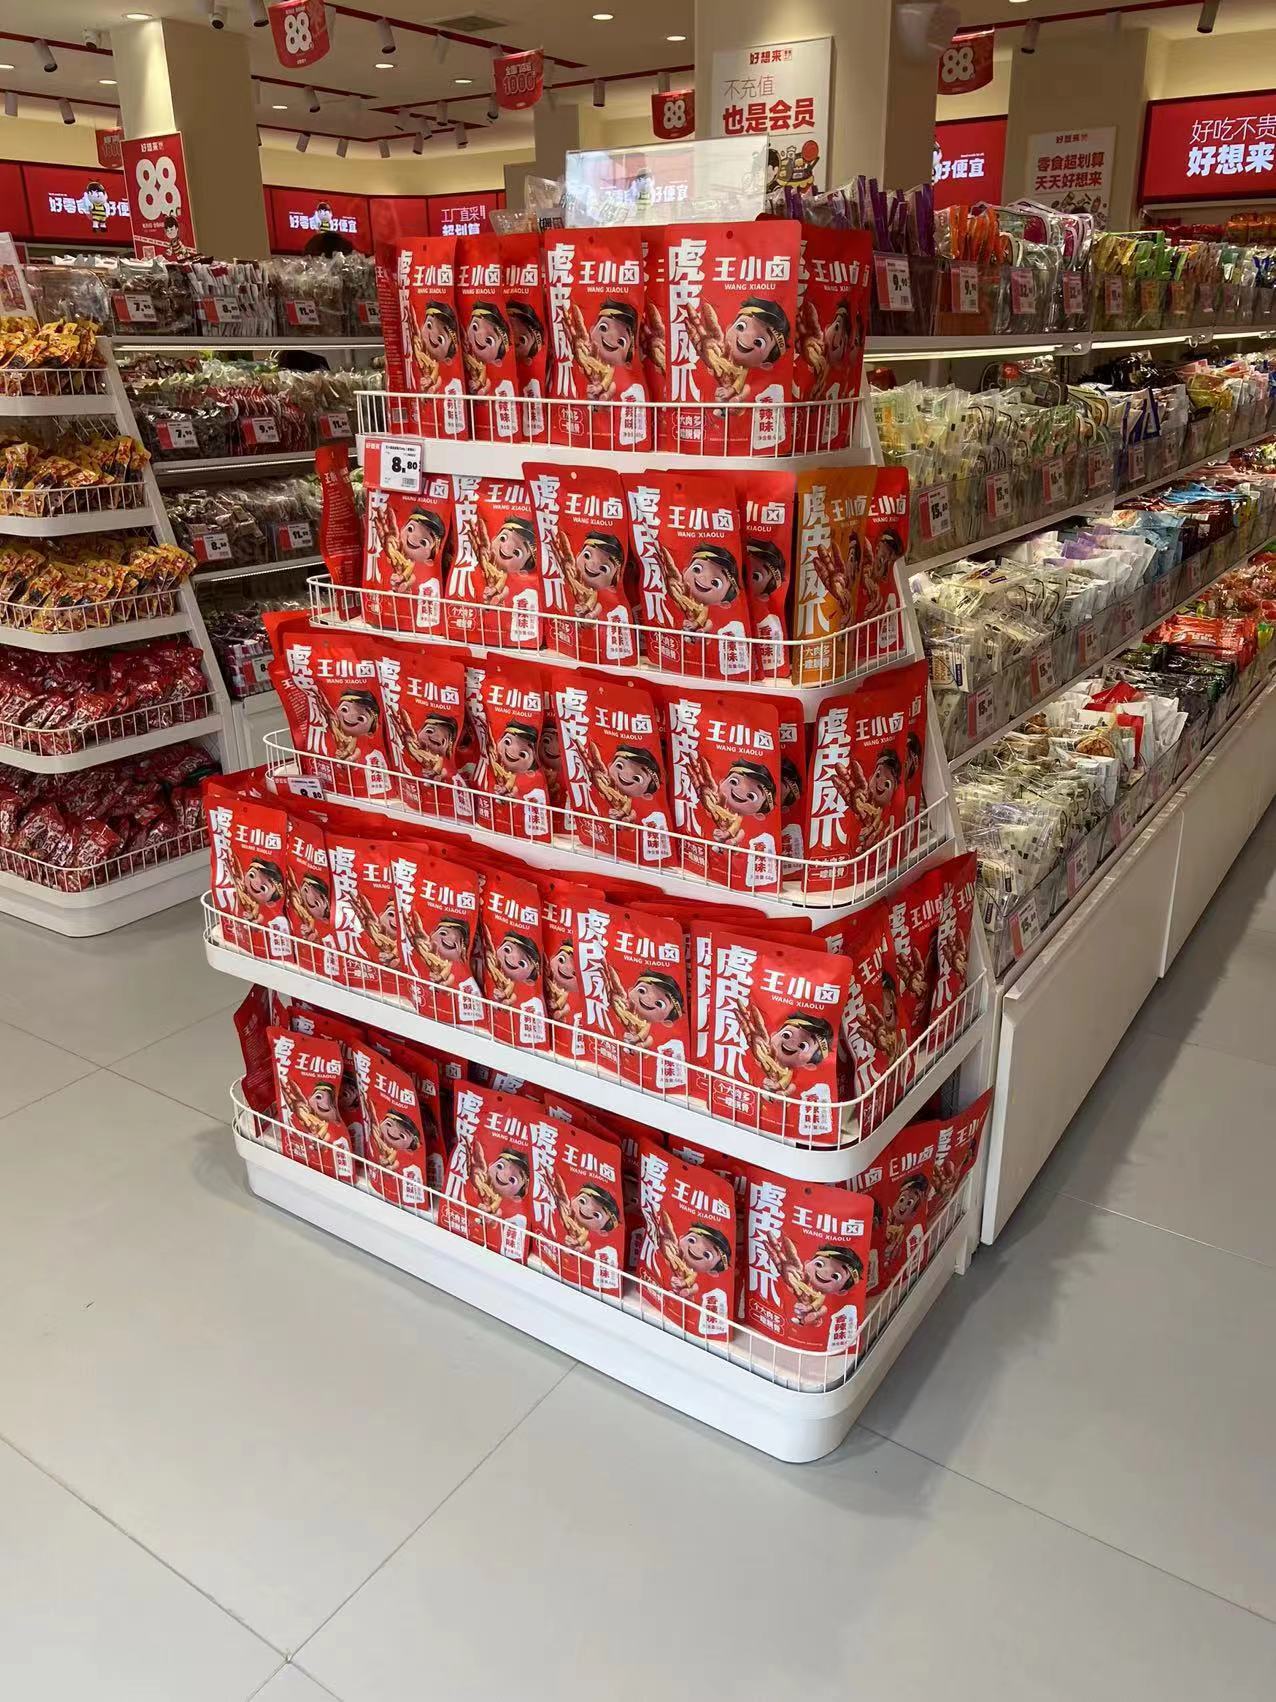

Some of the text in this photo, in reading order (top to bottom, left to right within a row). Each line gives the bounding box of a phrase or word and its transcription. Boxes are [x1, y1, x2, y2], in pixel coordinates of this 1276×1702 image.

[284, 12, 312, 54] 88
[750, 50, 781, 64] 好想来
[941, 47, 975, 82] 88
[723, 75, 774, 100] 不充值
[664, 100, 686, 129] 88
[723, 98, 815, 135] 也是会员
[1190, 114, 1276, 144] 好吃不贵
[933, 158, 984, 179] 好便宜
[1037, 152, 1105, 172] 零食超划算
[1187, 142, 1275, 177] 好想来
[136, 157, 181, 220] 88
[1035, 171, 1102, 191] 天天好想来
[412, 264, 453, 287] 王小卤
[457, 264, 501, 287] 王小卤
[579, 260, 640, 285] 王小卤
[712, 255, 791, 282] 王小卤
[725, 283, 747, 291] WANG
[668, 239, 707, 402] 虎皮凤爪
[392, 456, 418, 473] 8.80
[565, 492, 624, 519] 王小卤
[667, 506, 734, 532] 王小卤
[529, 474, 568, 613] 虎皮凤爪
[628, 485, 675, 628] 虎皮凤爪
[317, 659, 376, 678] 王小卤
[407, 676, 460, 705] 王小卤
[488, 685, 542, 712] 王小卤
[595, 706, 653, 734] 王小卤
[706, 720, 774, 750] 王小卤
[856, 711, 904, 741] 王小卤
[556, 687, 600, 816] 虎皮凤爪
[716, 744, 764, 756] WANG XIAOLU
[669, 698, 702, 837] 虎皮凤爪
[810, 707, 852, 849] 虎皮凤爪
[235, 824, 282, 850] 王小卤
[291, 836, 328, 867] 王小卤
[420, 879, 476, 910] 王小卤
[488, 892, 538, 926] 王小卤
[614, 931, 680, 963] 王小卤
[577, 908, 615, 1037] 虎皮凤爪
[645, 959, 671, 968] XIAOLU
[760, 969, 841, 1004] 王小卤
[714, 944, 758, 1083] 虎皮凤爪
[771, 994, 825, 1010] WANG XIAOLU
[294, 1053, 341, 1076] 王小卤
[374, 1073, 416, 1106] 王小卤
[562, 1143, 615, 1182] 王小卤
[671, 1178, 731, 1220] 王小卤
[792, 1205, 864, 1236] 王小卤
[802, 1228, 852, 1242] WANG XIAOLU
[750, 1181, 787, 1307] 虎皮凤爪
